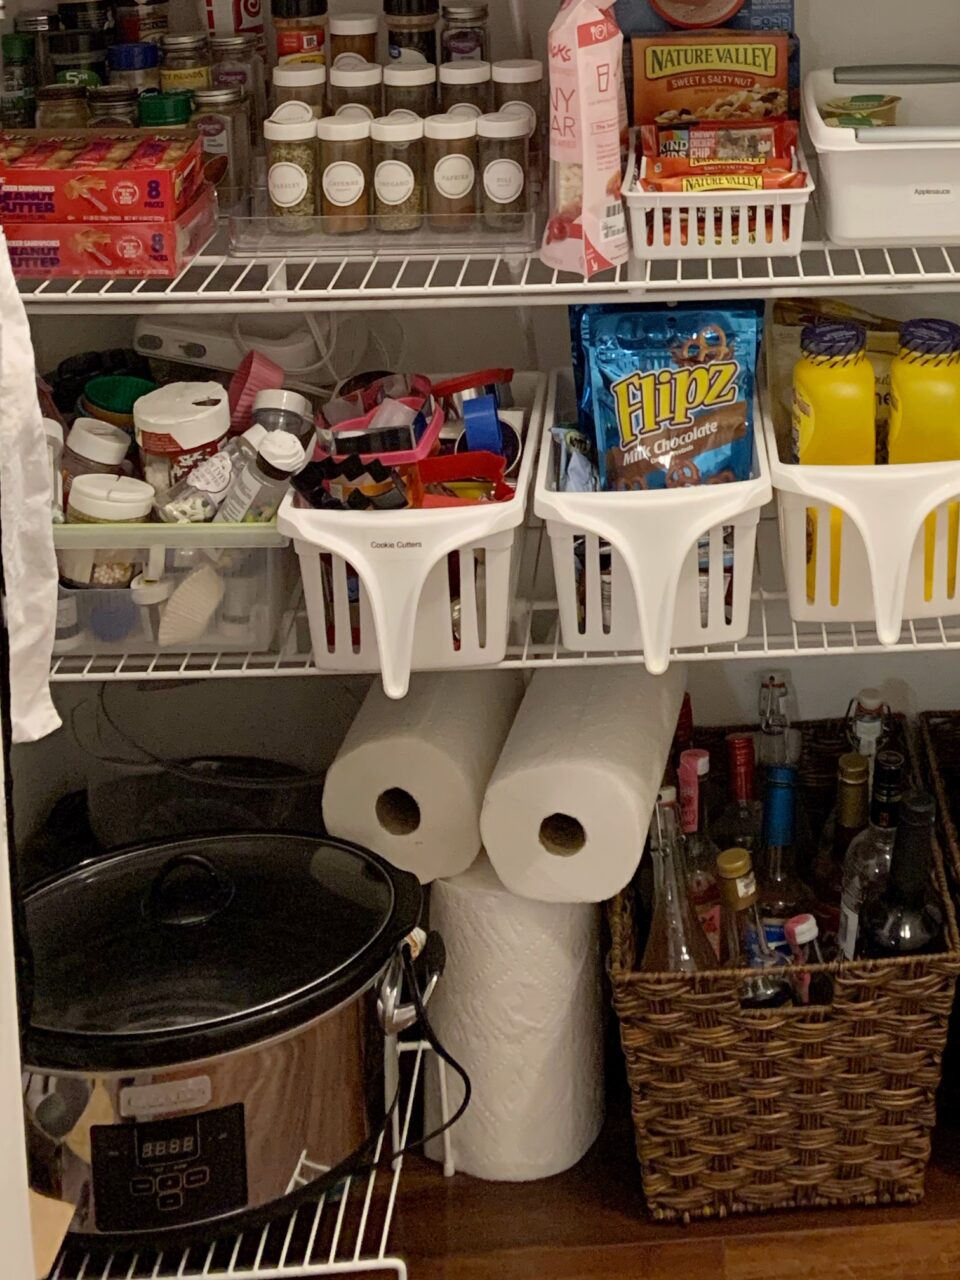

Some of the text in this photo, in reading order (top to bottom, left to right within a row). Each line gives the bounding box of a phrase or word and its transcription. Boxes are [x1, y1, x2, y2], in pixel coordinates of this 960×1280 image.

[651, 47, 772, 74] NATURE VALLEY
[672, 76, 700, 88] SWEET
[707, 75, 734, 85] SALTY
[735, 78, 752, 86] NUT
[660, 140, 689, 152] KIND
[690, 148, 710, 157] CHIP
[147, 180, 161, 199] 8
[686, 176, 762, 192] NATURE VALLEY
[152, 233, 164, 253] 8
[612, 360, 740, 450] Flipz
[623, 445, 651, 466] Milk
[653, 421, 718, 454] Chocolate
[371, 541, 422, 549] Cookie Cutters
